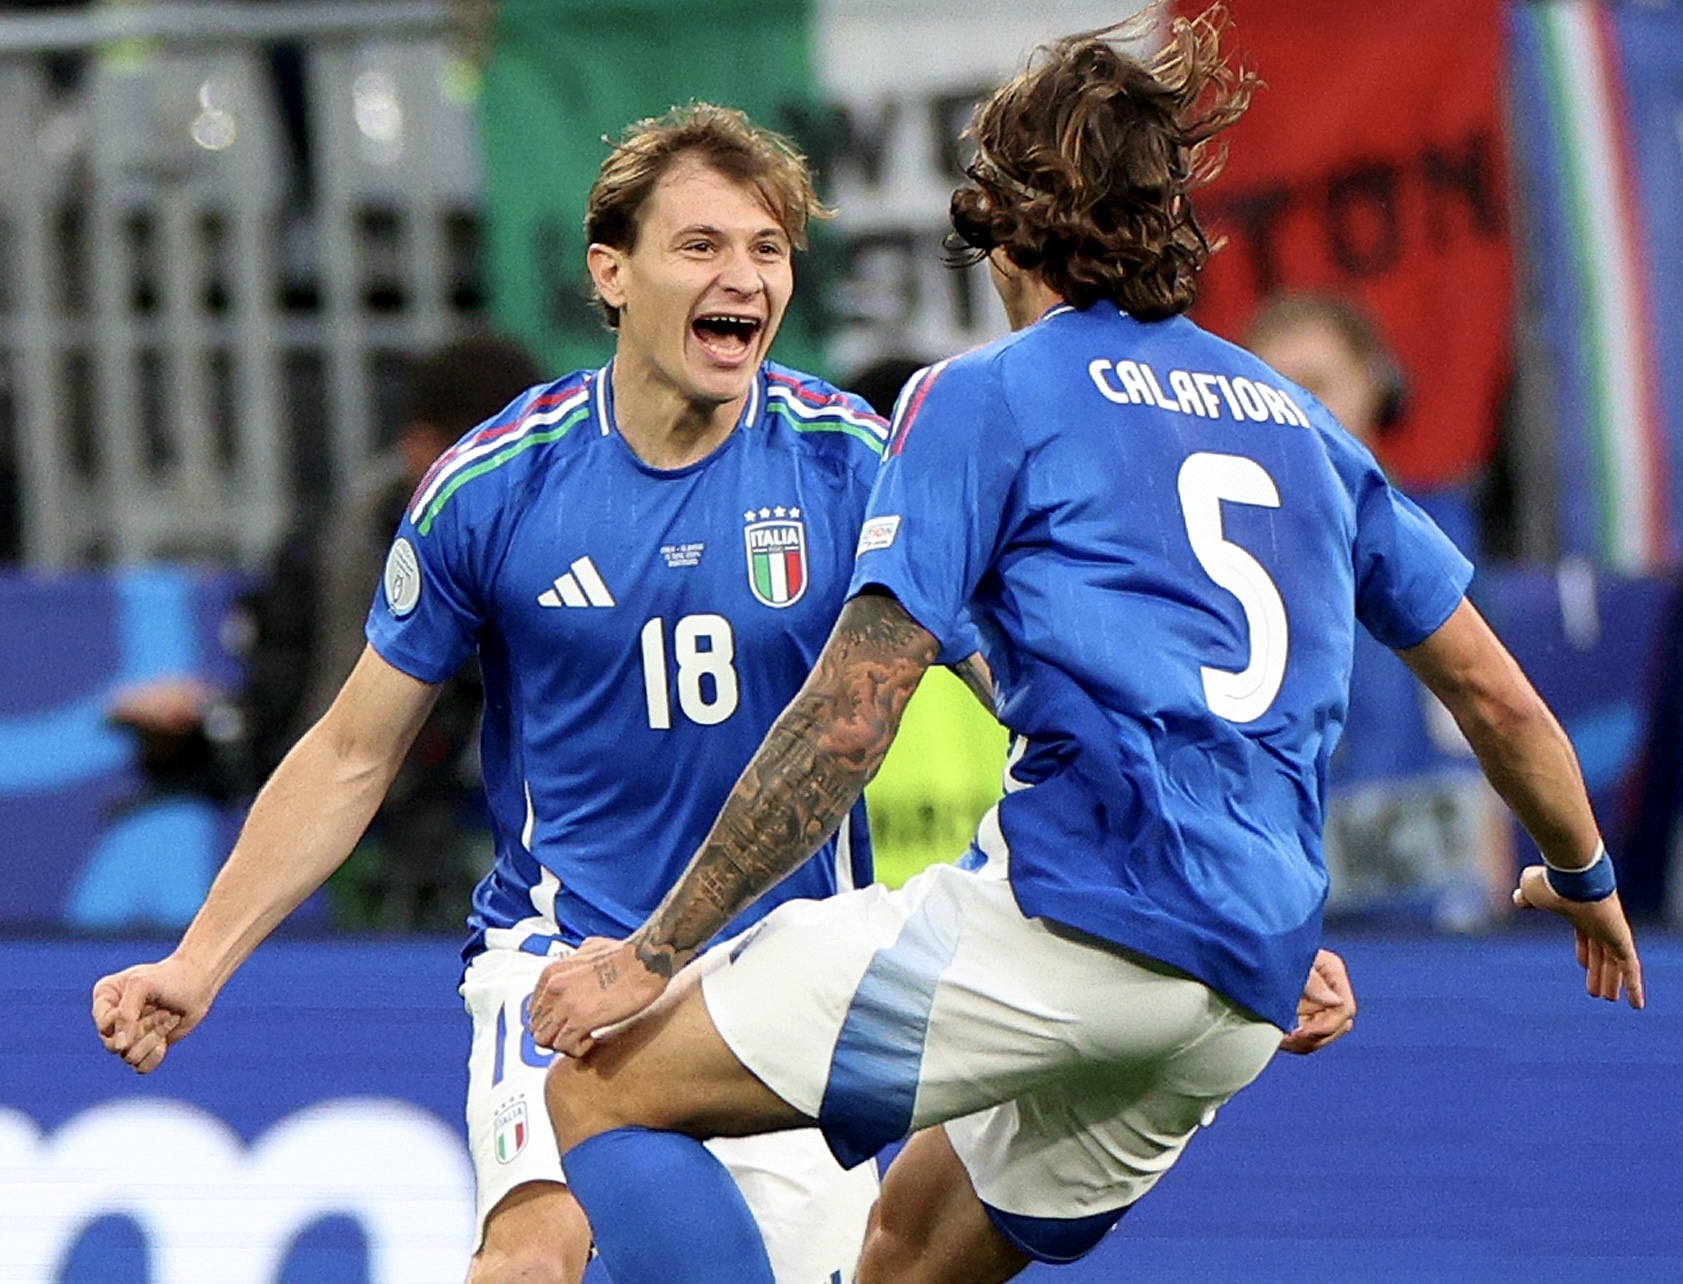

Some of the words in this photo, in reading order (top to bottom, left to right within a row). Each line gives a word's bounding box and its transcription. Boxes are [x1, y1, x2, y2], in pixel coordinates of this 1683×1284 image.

[1088, 359, 1311, 429] CALAFIORI
[750, 527, 799, 548] ITALIA
[1177, 451, 1290, 723] 5
[641, 614, 739, 729] 18
